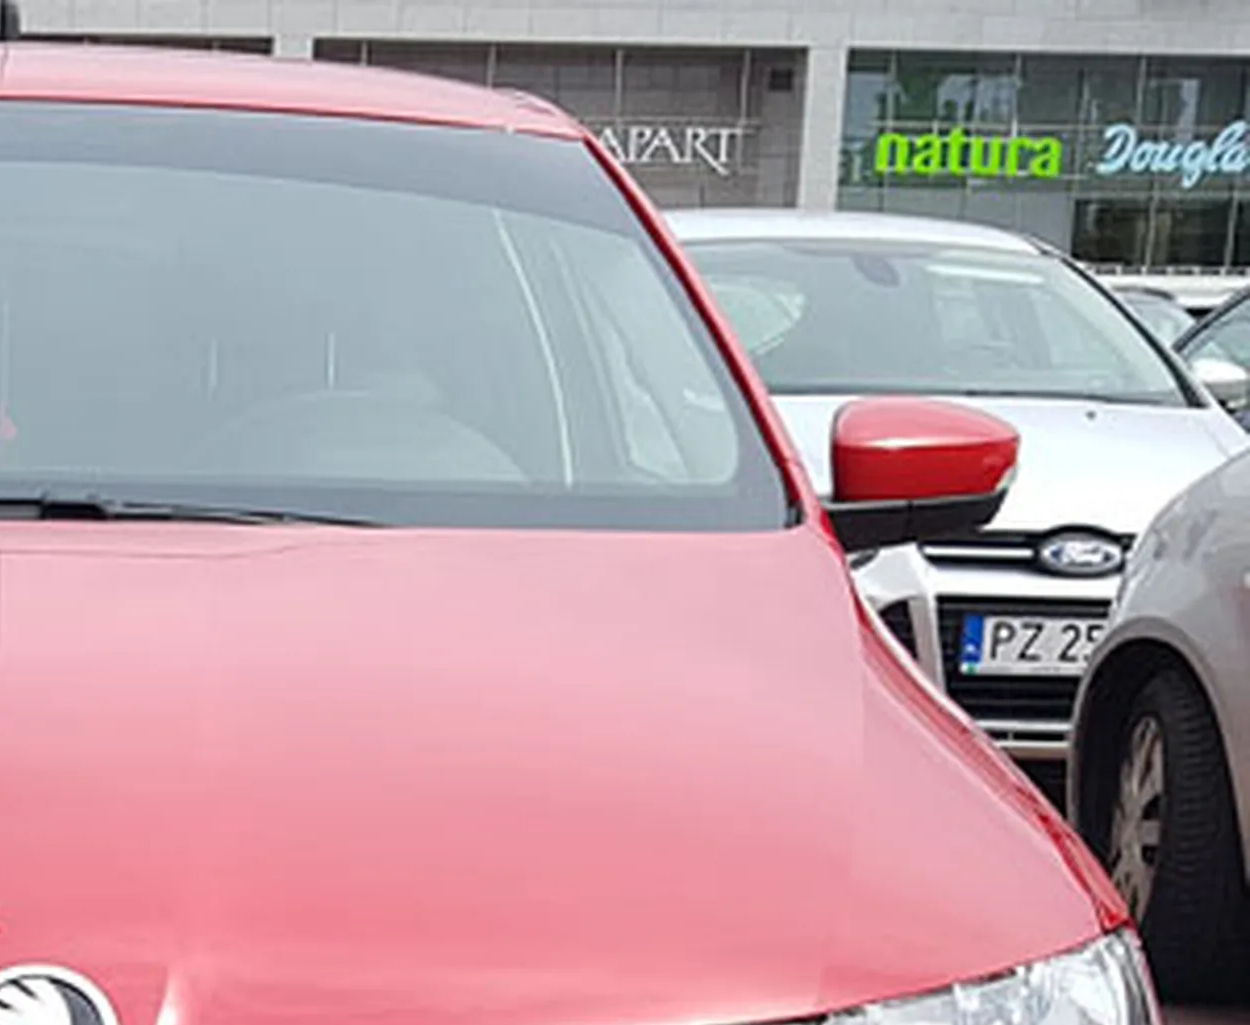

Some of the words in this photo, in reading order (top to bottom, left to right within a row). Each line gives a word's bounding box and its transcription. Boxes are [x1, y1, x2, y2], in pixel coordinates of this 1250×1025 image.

[600, 126, 742, 176] APART
[875, 127, 1063, 178] natura
[1096, 120, 1250, 189] Dougla
[990, 621, 1044, 662] PZ
